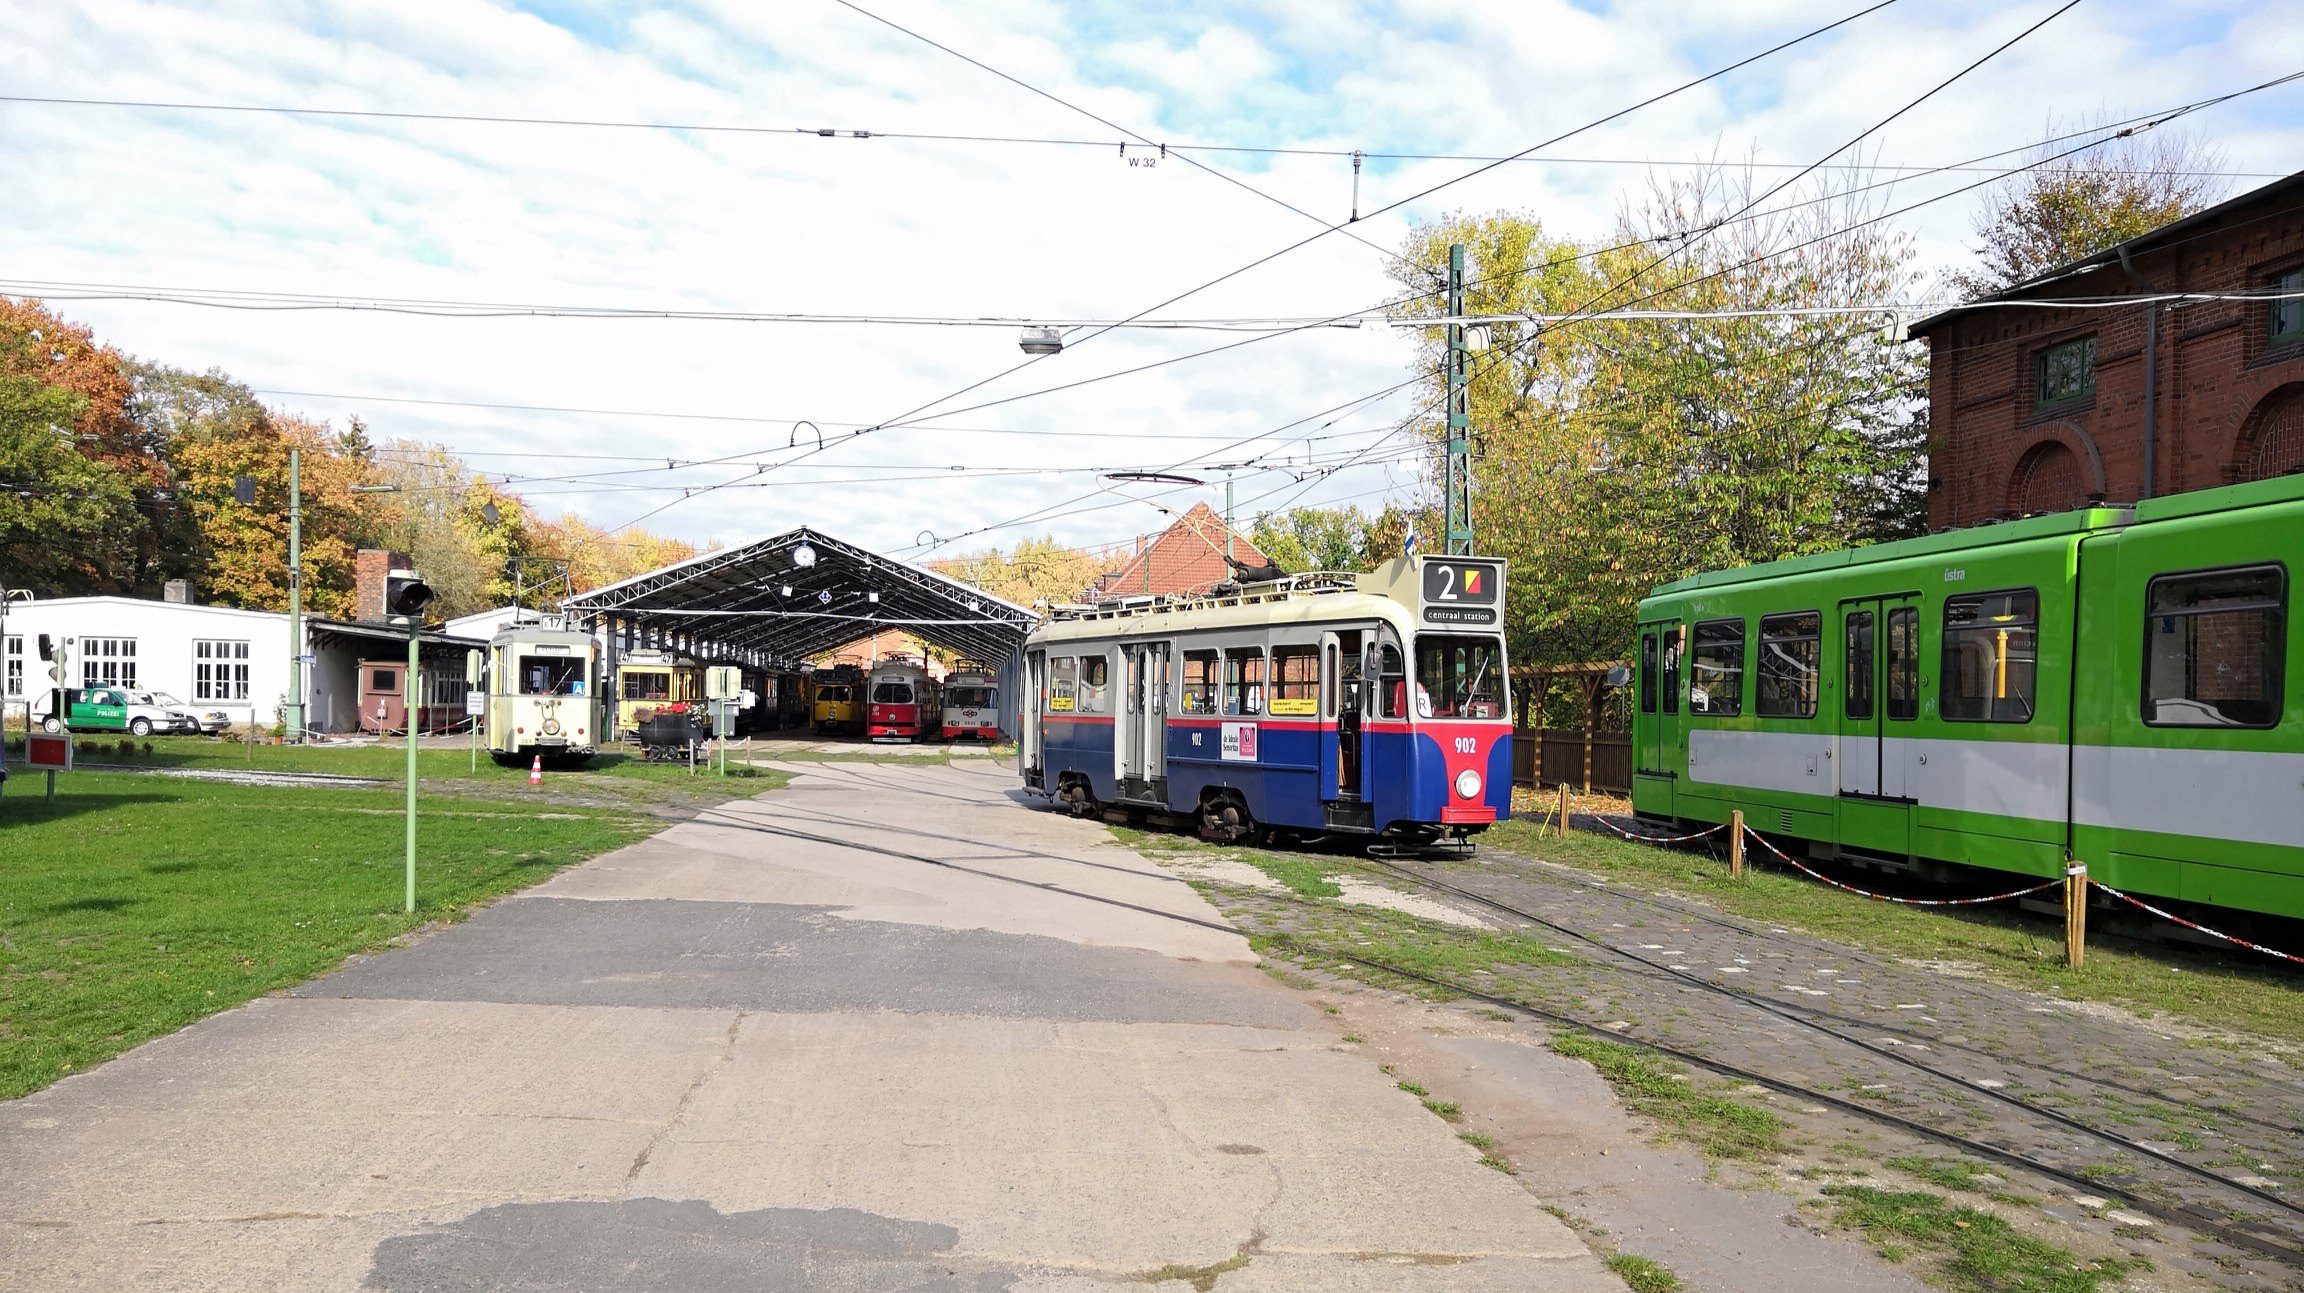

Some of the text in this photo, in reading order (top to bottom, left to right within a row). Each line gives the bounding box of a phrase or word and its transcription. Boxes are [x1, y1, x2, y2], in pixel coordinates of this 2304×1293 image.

[1129, 158, 1156, 167] W 32
[1945, 567, 1965, 581] üstra
[1438, 565, 1457, 600] 2
[1428, 611, 1490, 621] centraal station
[574, 684, 583, 695] A
[1419, 698, 1427, 710] R
[1191, 732, 1202, 746] 902
[1455, 737, 1476, 754] 902
